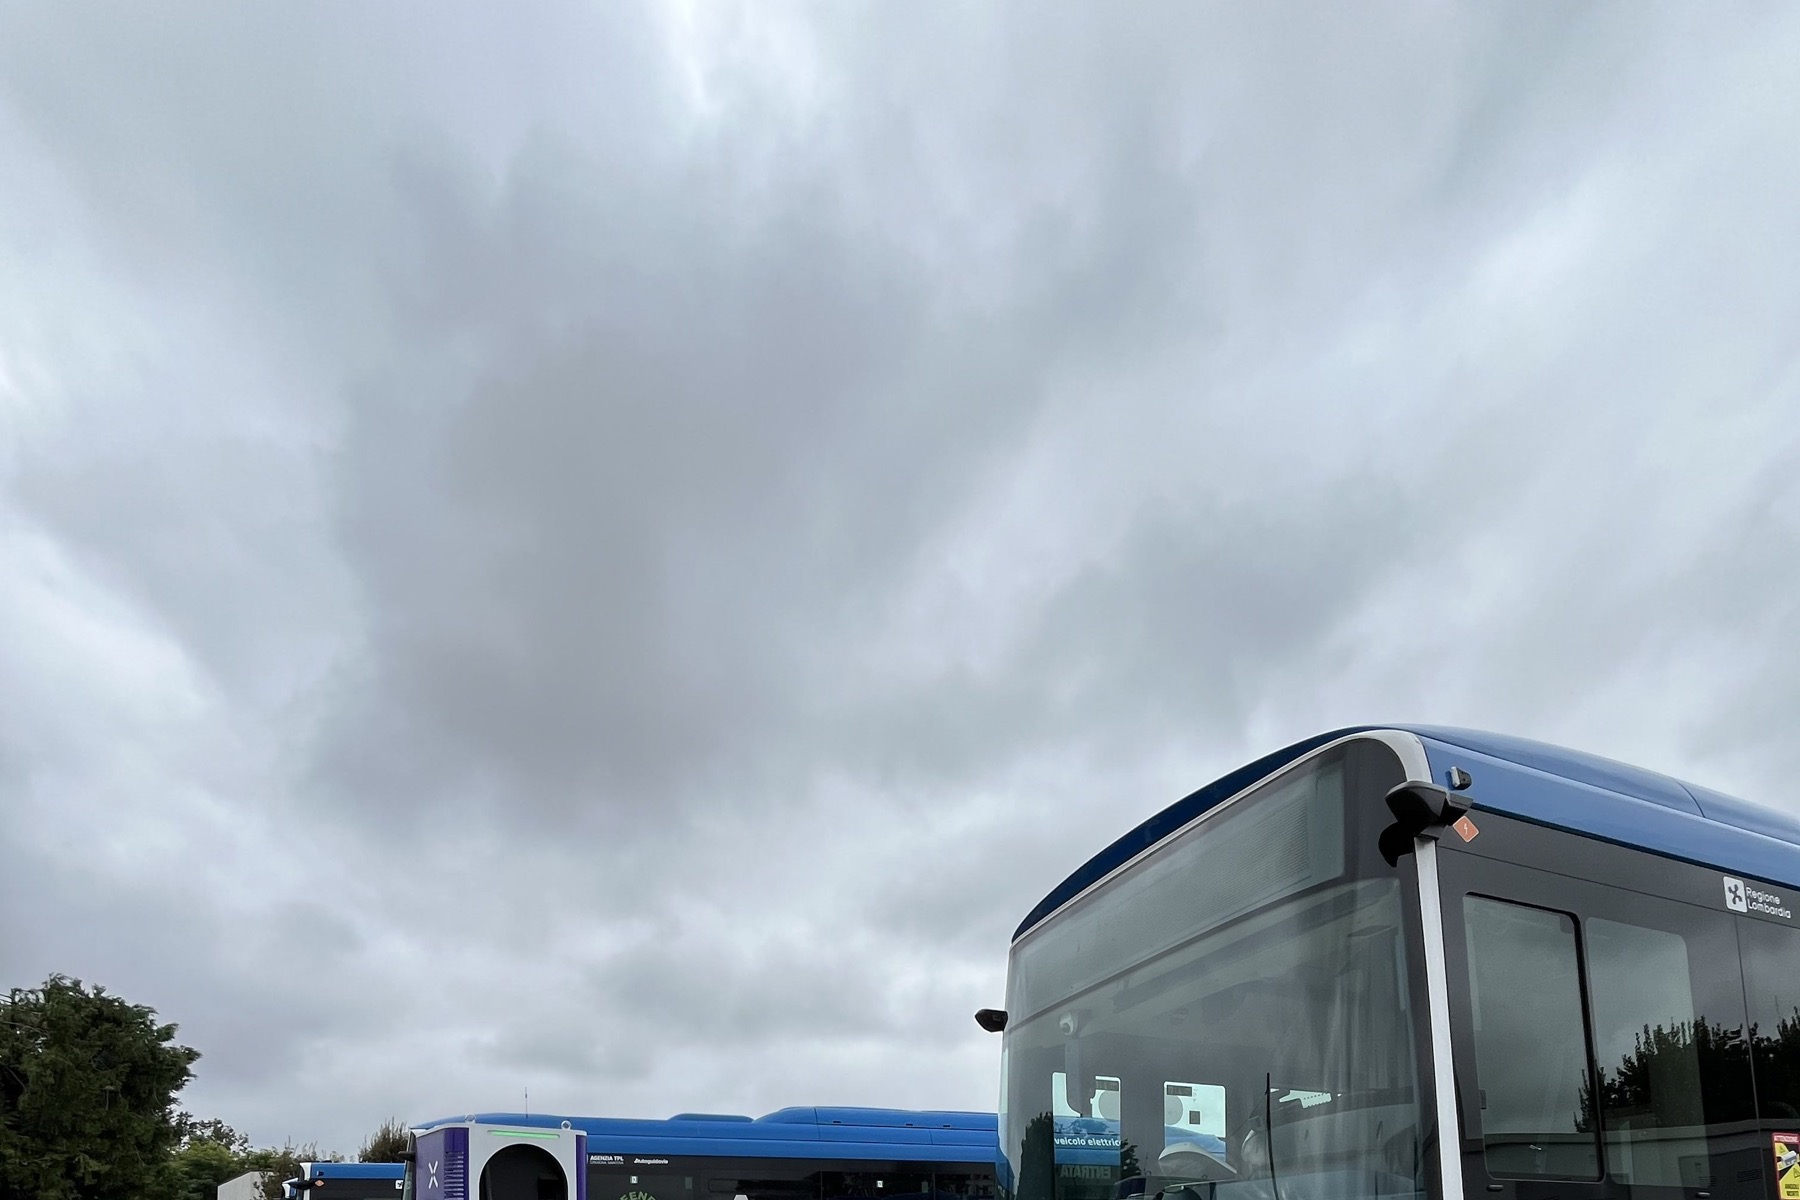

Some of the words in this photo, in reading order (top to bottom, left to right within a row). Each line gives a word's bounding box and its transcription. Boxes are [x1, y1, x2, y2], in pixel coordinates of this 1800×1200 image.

[1746, 887, 1780, 904] Regione
[1748, 898, 1791, 918] Lombardia
[1054, 1137, 1085, 1146] veicolo
